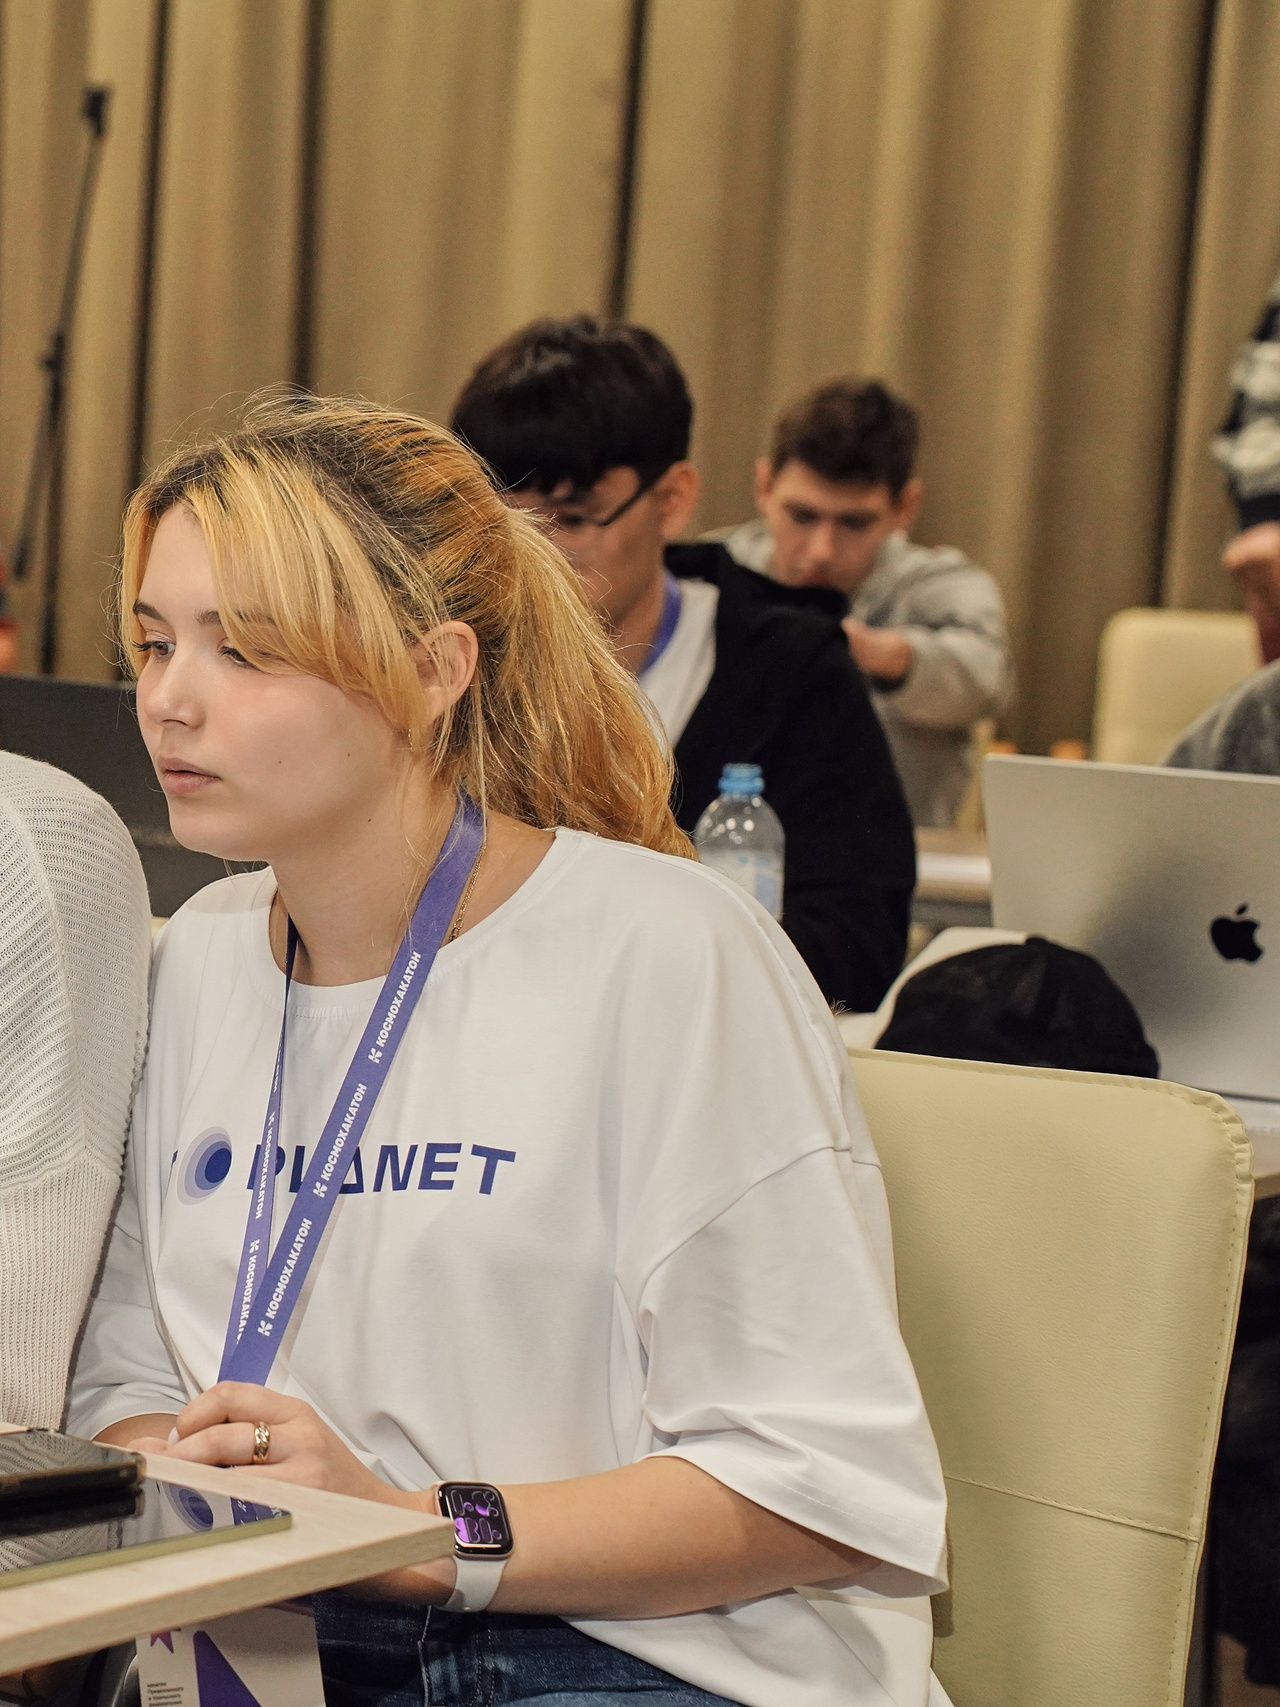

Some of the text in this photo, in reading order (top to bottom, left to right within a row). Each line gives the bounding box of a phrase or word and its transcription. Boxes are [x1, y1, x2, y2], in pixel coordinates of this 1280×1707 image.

[376, 951, 422, 1048] КОСМОХАКАТОН
[255, 1127, 274, 1220] КОСМОХАКАТОН
[322, 1083, 368, 1182] КОСМОХАКАТОН
[267, 1217, 314, 1320] КОСМОХАКАТОН
